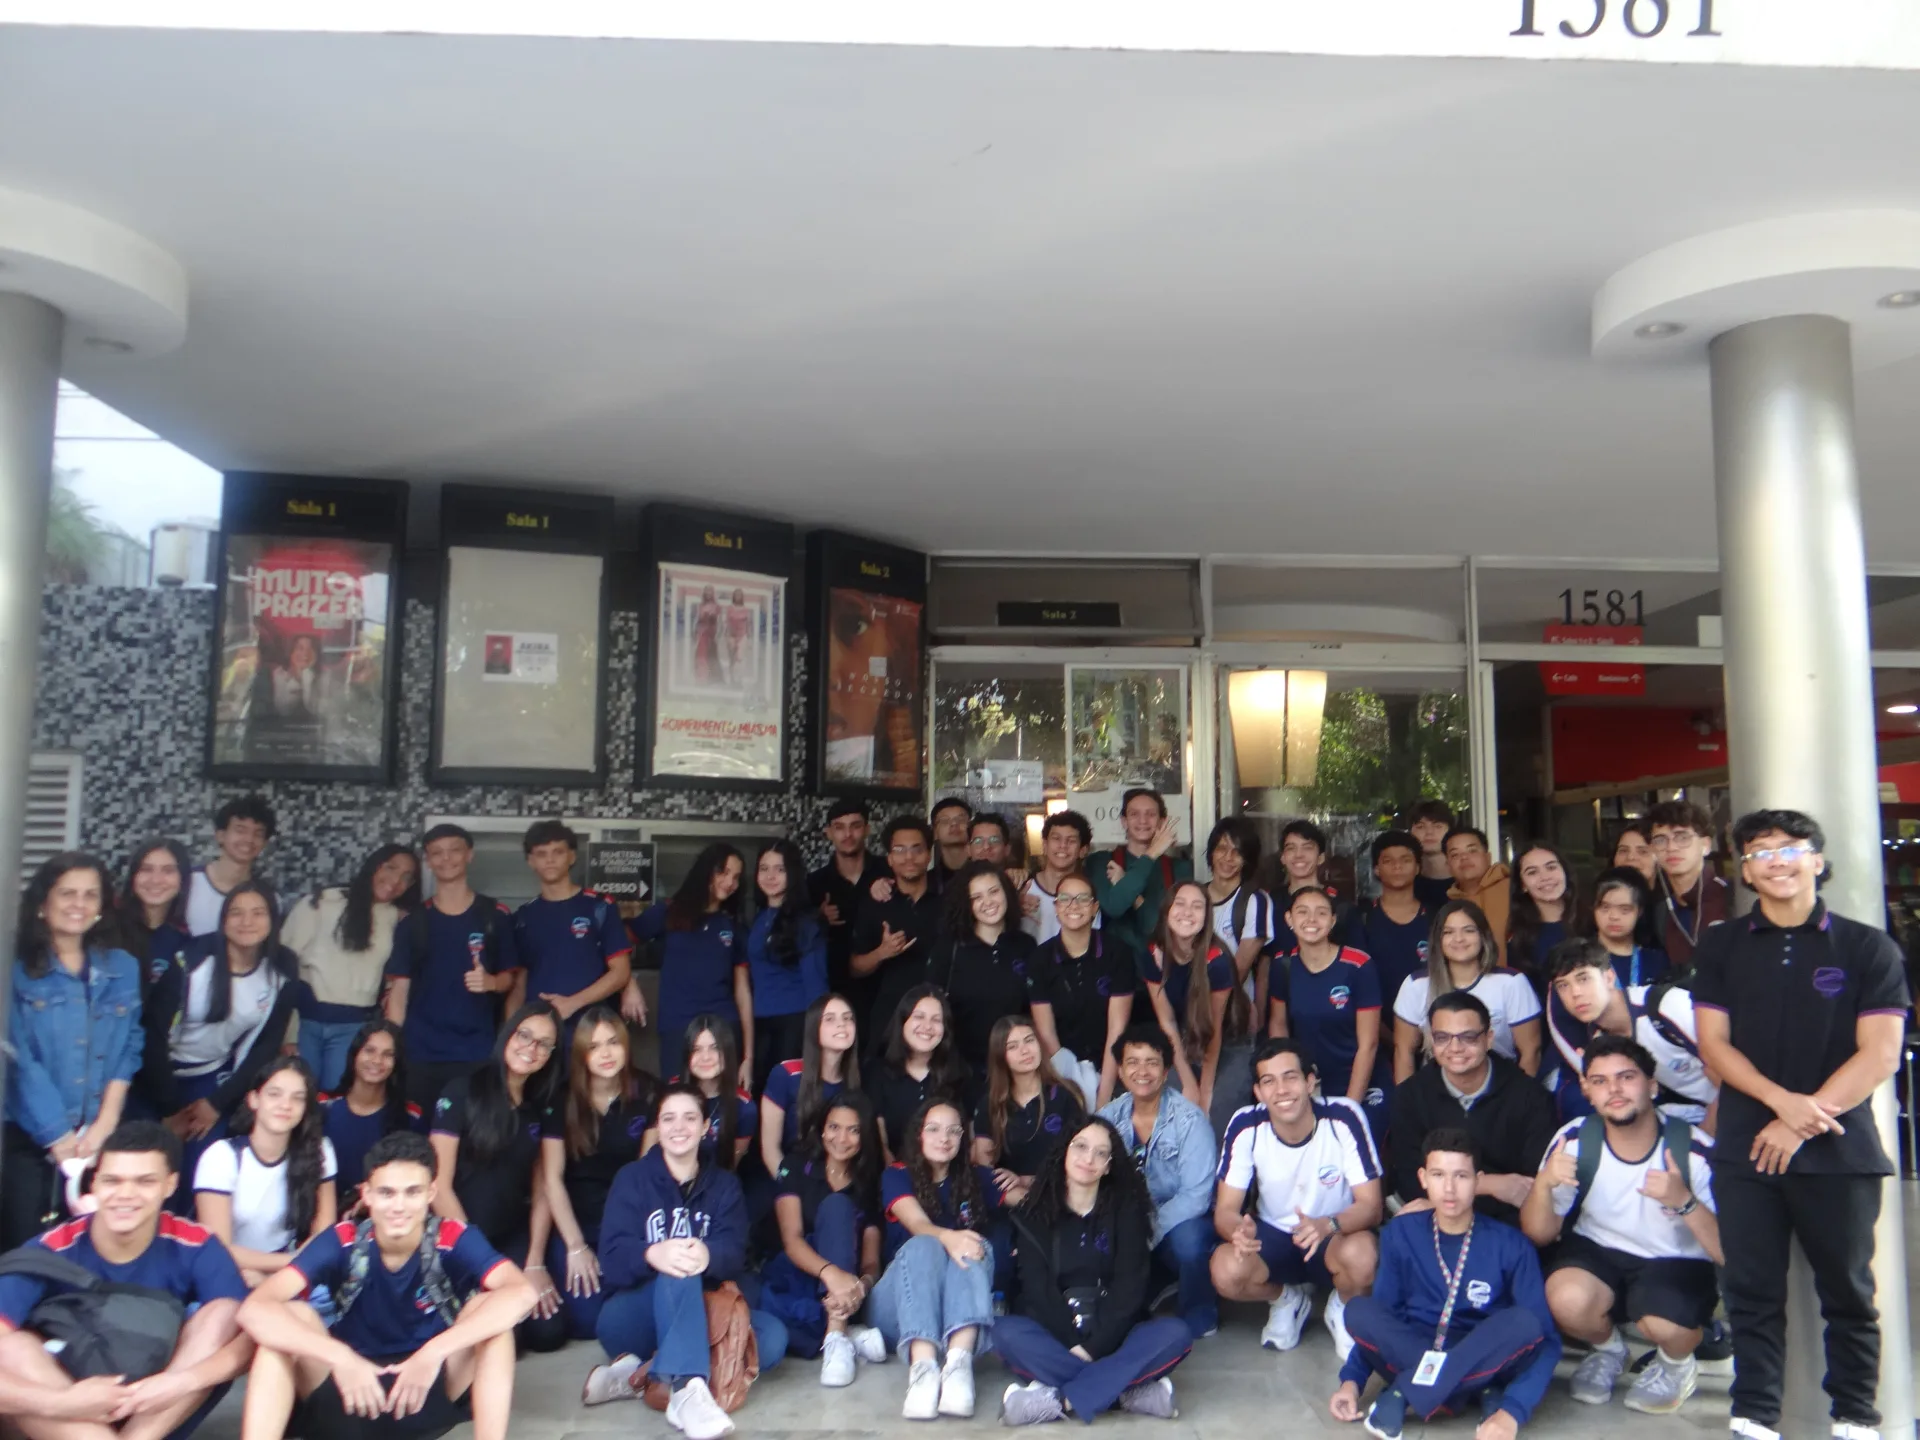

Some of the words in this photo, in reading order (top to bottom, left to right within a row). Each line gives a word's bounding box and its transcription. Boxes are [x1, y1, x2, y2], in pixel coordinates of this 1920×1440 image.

[287, 499, 322, 515] Sala
[329, 502, 336, 516] 1
[507, 512, 538, 527] Sala
[542, 516, 549, 528] 1
[704, 531, 732, 548] Sala
[736, 536, 743, 549] 1
[861, 561, 881, 576] Sala
[254, 568, 355, 595] MUITO
[253, 592, 363, 620] PRAZER
[1042, 610, 1067, 619] Sala
[1559, 587, 1648, 627] 1581
[593, 883, 637, 893] ACESSO
